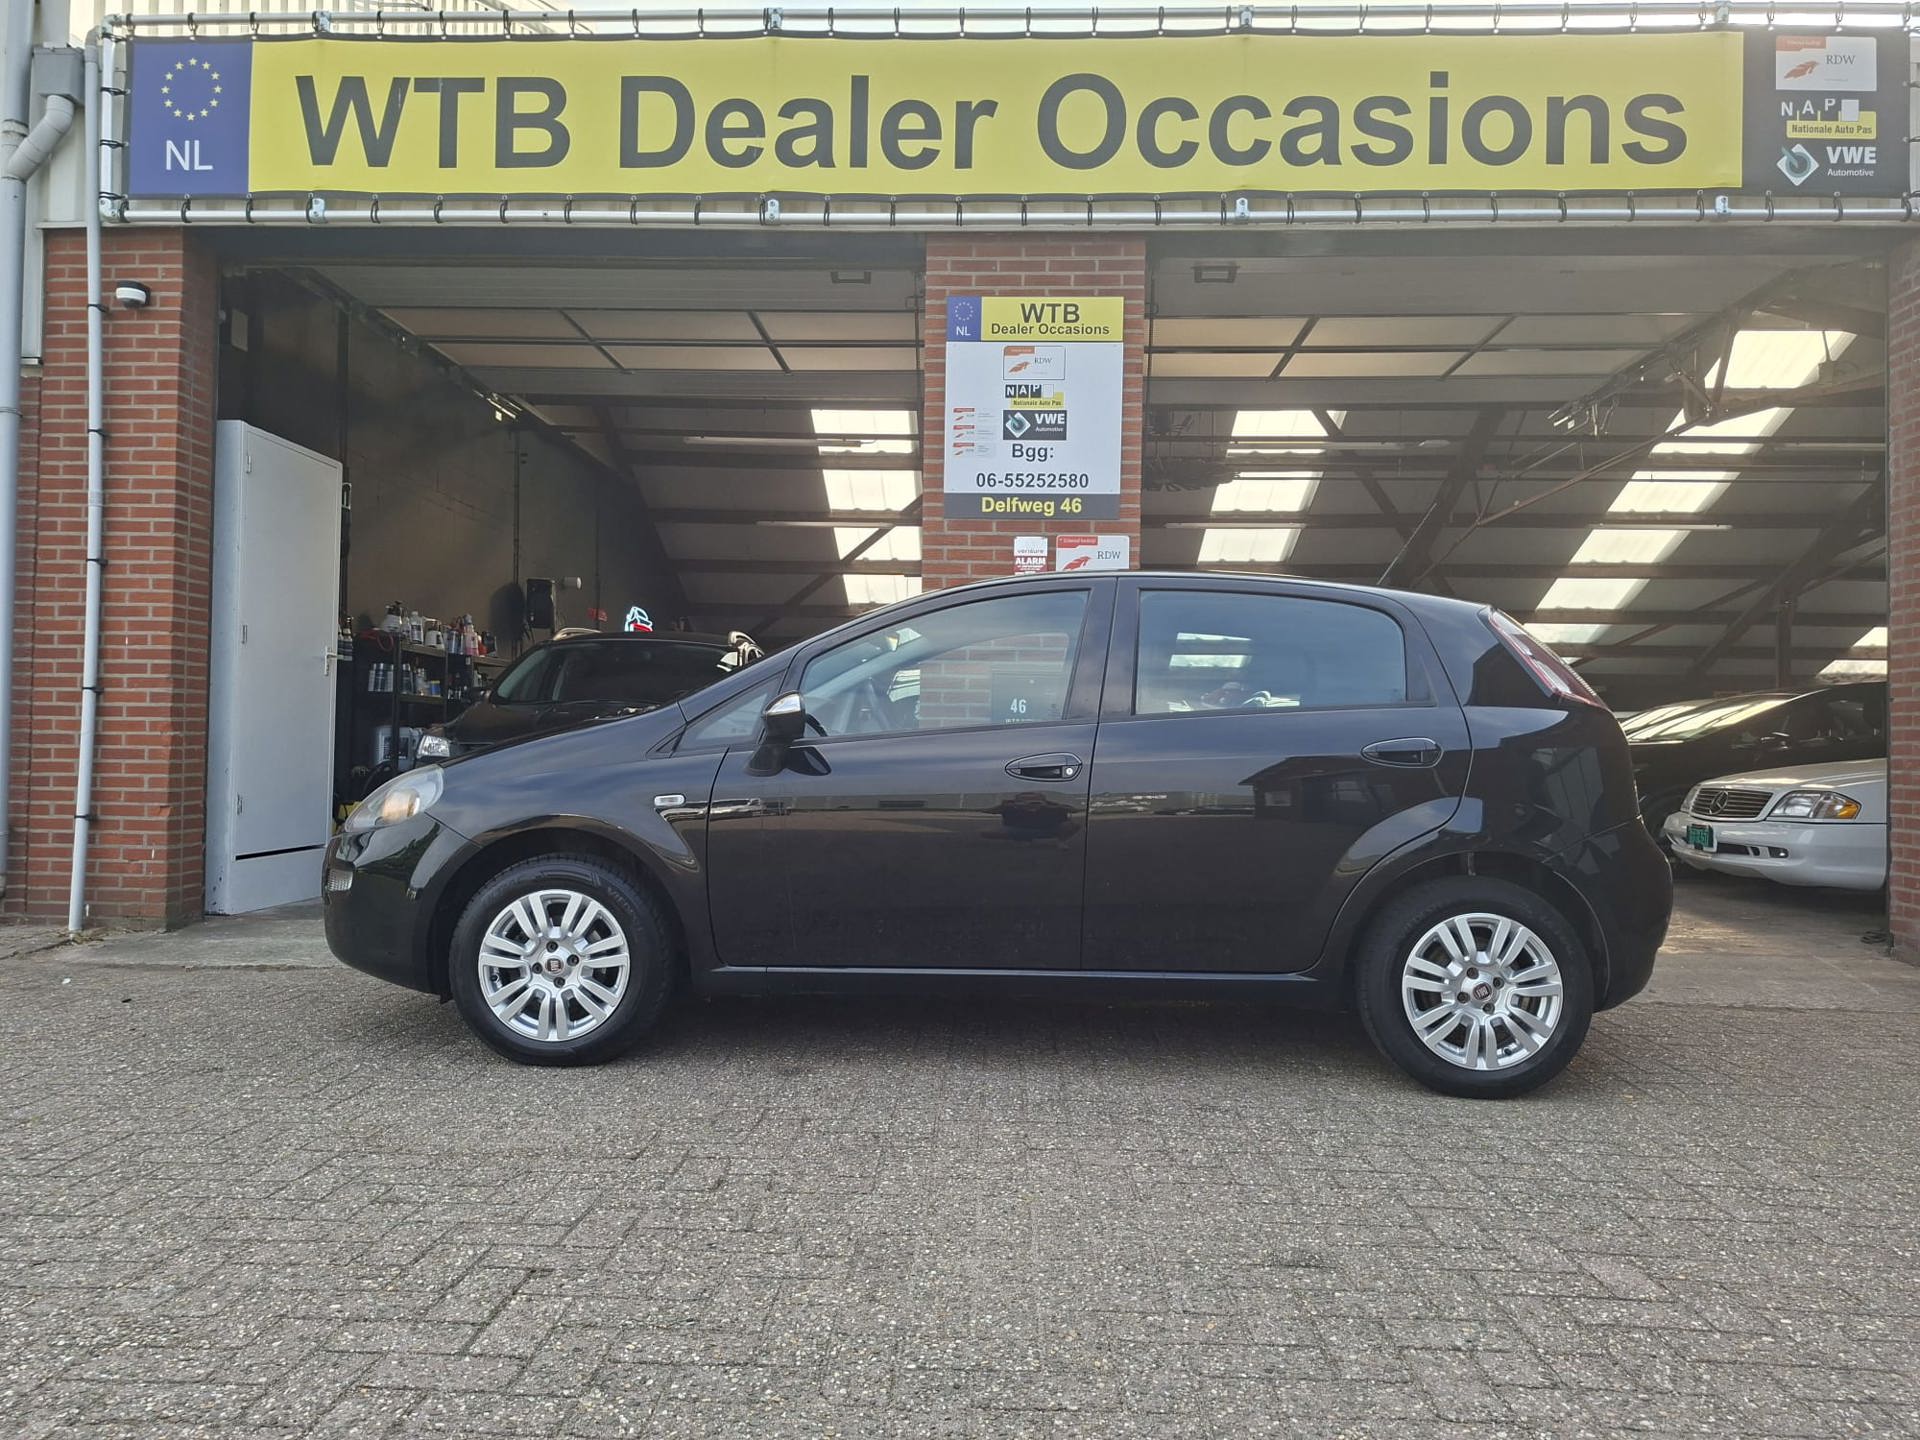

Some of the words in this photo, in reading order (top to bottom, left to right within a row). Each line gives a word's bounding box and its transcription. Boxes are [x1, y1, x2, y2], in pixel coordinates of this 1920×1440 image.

[1826, 54, 1856, 65] RDW
[294, 74, 571, 169] WTB
[620, 74, 999, 170] Dealer
[1037, 70, 1688, 170] Occasions
[1791, 124, 1833, 135] Nationale
[1834, 125, 1855, 135] Auto
[1856, 125, 1873, 135] Pas
[166, 139, 213, 171] NL
[1826, 146, 1877, 164] VWE
[1827, 168, 1875, 177] Automotive
[1020, 303, 1080, 323] WTB
[955, 325, 972, 336] NL
[991, 323, 1035, 335] Dealer
[1038, 323, 1110, 335] Occasions
[1034, 413, 1066, 425] VWE
[1011, 443, 1054, 462] Bgg:
[976, 472, 1089, 489] 06-55252580
[981, 496, 1055, 517] Delfweg
[1060, 497, 1082, 513] 46
[1015, 557, 1046, 566] ALARM
[1097, 550, 1121, 560] RDW
[1010, 698, 1027, 714] 46
